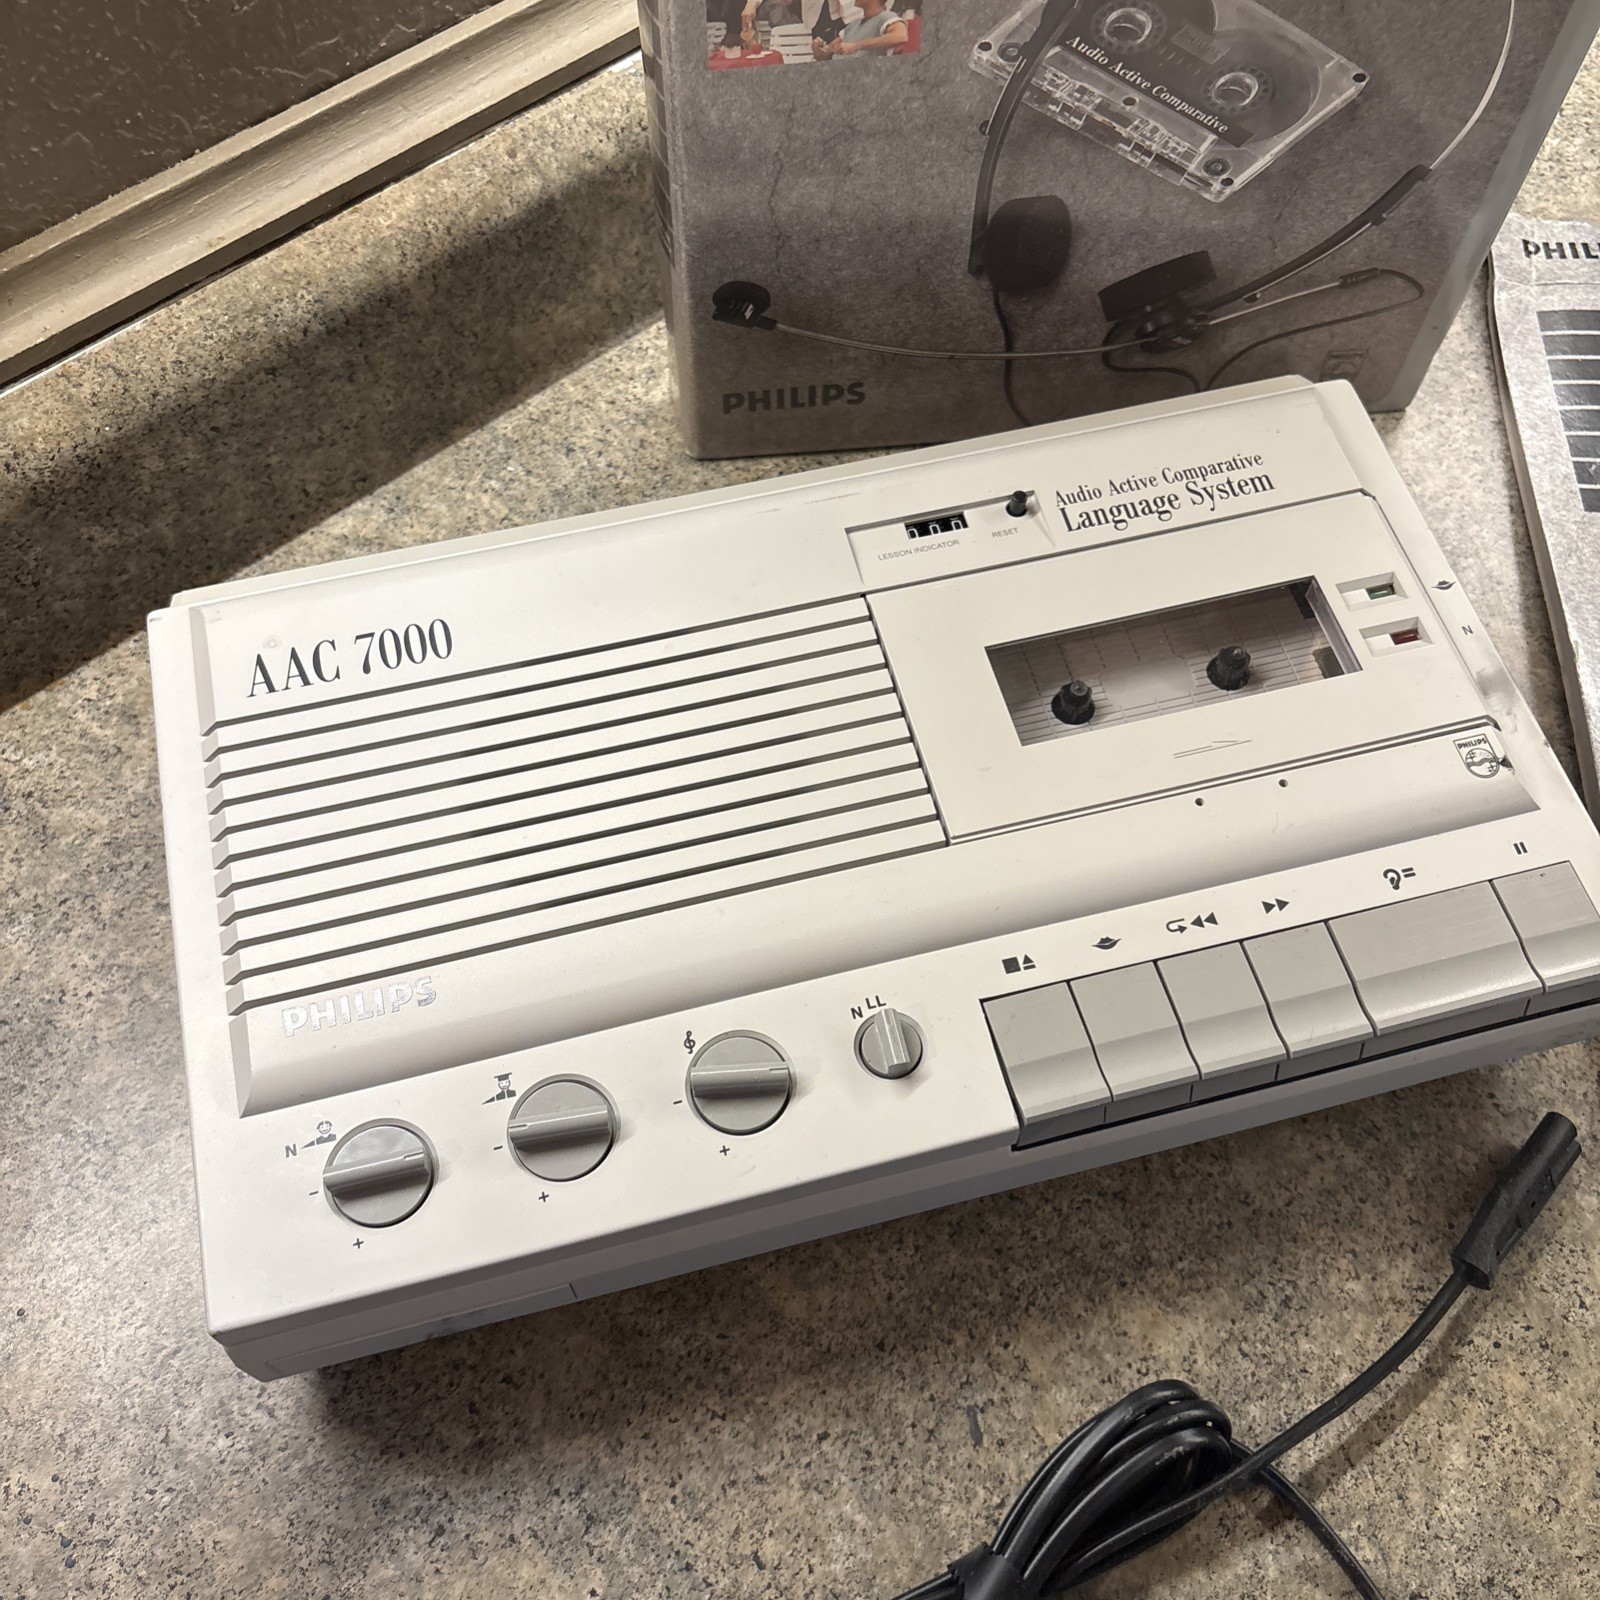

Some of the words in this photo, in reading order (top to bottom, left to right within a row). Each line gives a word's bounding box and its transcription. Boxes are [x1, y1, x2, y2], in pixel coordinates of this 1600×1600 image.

[1065, 36, 1109, 65] Audio
[1109, 61, 1151, 89] Active
[1151, 84, 1229, 134] Comparative
[722, 382, 866, 415] PHILIPS
[1055, 484, 1102, 507] Audio
[1108, 475, 1158, 496] Active
[1161, 453, 1264, 484] Comparative
[1058, 493, 1181, 532] Language
[1185, 473, 1276, 511] System
[991, 527, 1019, 538] RESET
[878, 548, 913, 561] LESSON
[914, 539, 961, 554] INDICATOR
[1461, 625, 1474, 636] N
[247, 639, 341, 698] AAC
[354, 618, 453, 675] 7000
[1457, 737, 1487, 749] PHILIPS
[281, 975, 437, 1038] PHILIPS
[850, 1006, 864, 1020] N
[284, 1143, 298, 1158] N
